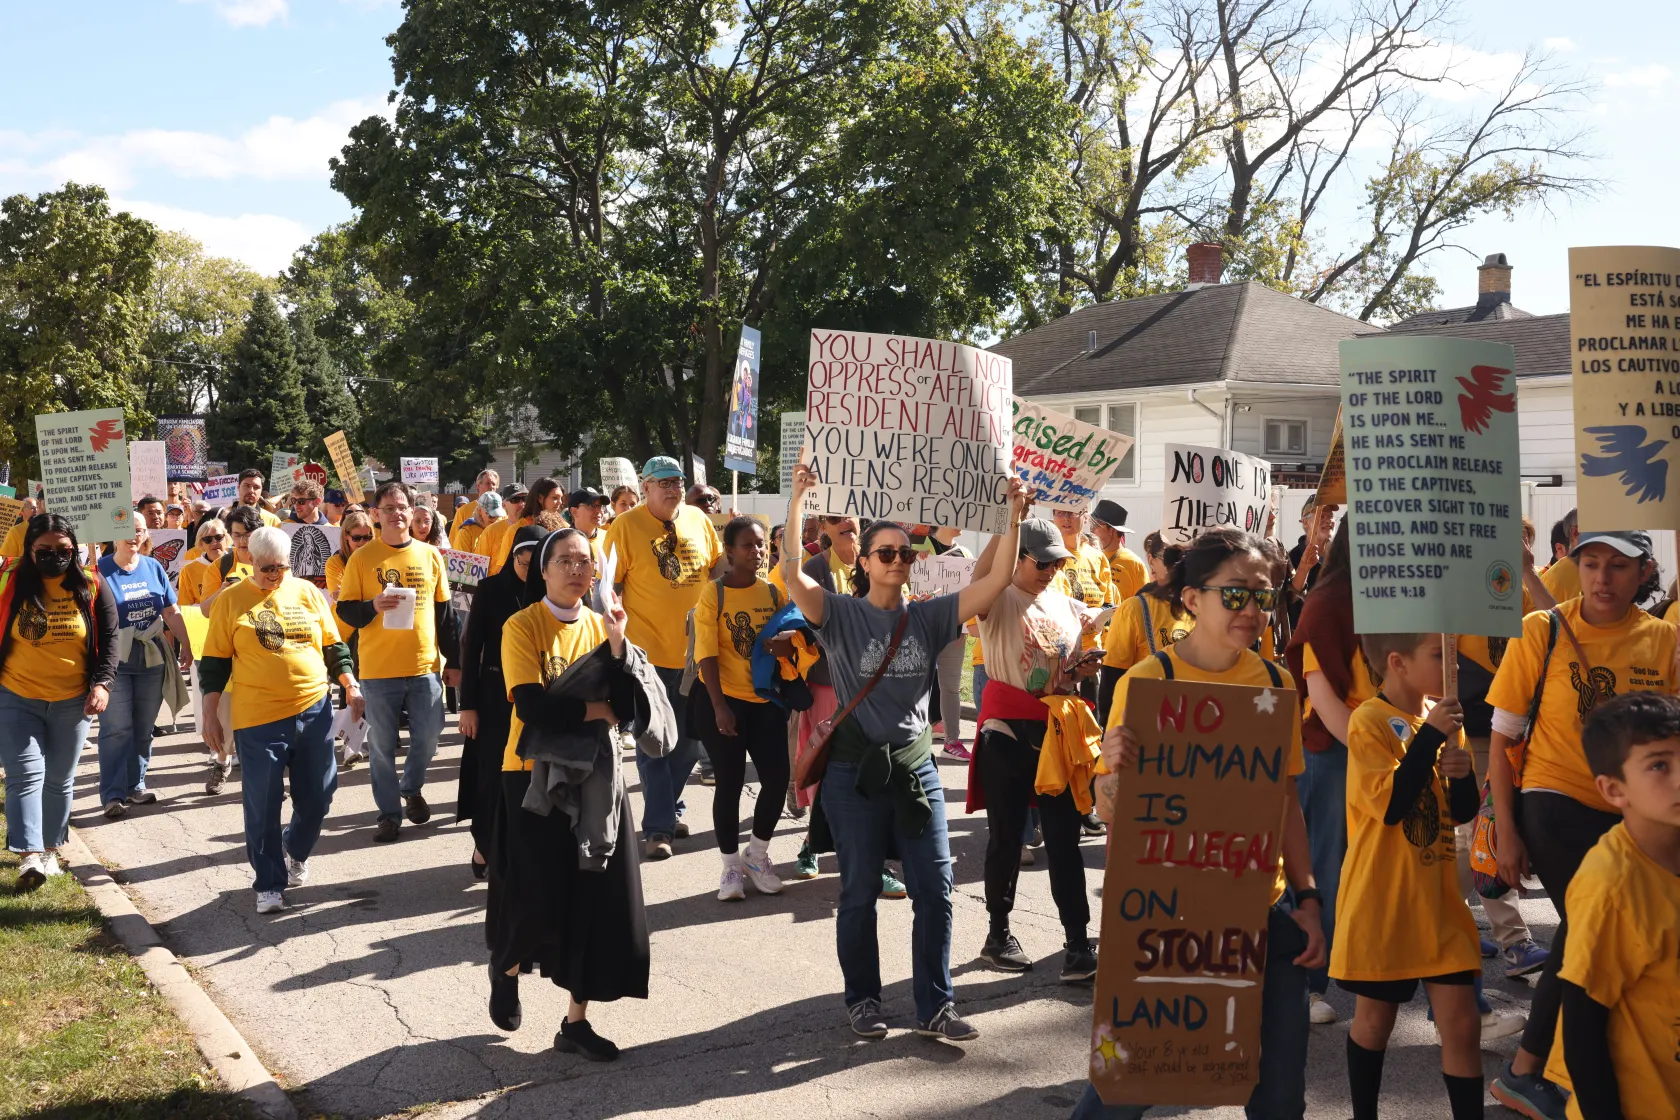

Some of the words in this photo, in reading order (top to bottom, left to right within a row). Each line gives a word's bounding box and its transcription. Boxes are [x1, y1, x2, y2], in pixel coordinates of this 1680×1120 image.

[1576, 273, 1601, 287] “EL
[1606, 269, 1671, 287] ESPÍRITU
[1630, 290, 1664, 307] ESTÁ
[1626, 314, 1646, 329] ME
[1651, 315, 1670, 329] HA
[1578, 336, 1667, 352] PROCLAMAR
[812, 332, 871, 362] YOU
[885, 338, 963, 374] SHALL
[975, 352, 1010, 386] NOT
[1581, 359, 1611, 374] LOS
[1618, 357, 1680, 373] CAUTIVO
[1348, 371, 1383, 384] “THE
[1389, 369, 1437, 383] SPIRIT
[810, 361, 917, 398] OPPRESS
[917, 374, 931, 385] or
[929, 373, 1006, 413] AFFLICT
[1655, 380, 1664, 394] A
[1349, 393, 1368, 406] OF
[1373, 391, 1400, 405] THE
[1406, 391, 1443, 405] LORD
[1618, 403, 1628, 417] Y
[1635, 402, 1645, 416] A
[808, 390, 937, 434] RESIDENT
[942, 405, 1005, 448] ALIEN,
[1350, 414, 1365, 428] IS
[1371, 412, 1411, 427] UPON
[1416, 412, 1447, 427] ME...
[58, 427, 78, 435] SPIRIT
[65, 436, 82, 444] LORD
[1351, 435, 1369, 449] HE
[1375, 434, 1404, 448] HAS
[1410, 434, 1444, 448] SENT
[1450, 435, 1465, 449] ME
[806, 424, 864, 458] YOU
[874, 430, 944, 465] WERE
[950, 440, 1006, 475] ONCE
[1087, 438, 1118, 476] by
[68, 455, 84, 463] SENT
[1013, 445, 1076, 479] grants
[1353, 457, 1372, 471] TO
[1377, 456, 1448, 470] PROCLAIM
[1453, 457, 1503, 475] RELEASE
[55, 465, 86, 474] PROCLAIM
[89, 462, 117, 472] RELEASE
[1171, 451, 1204, 484] NO
[1212, 455, 1244, 490] ONE
[70, 474, 103, 482] CAPTIVES,
[305, 472, 325, 482] TOP
[808, 455, 902, 490] ALIENS
[913, 464, 1008, 506] RESIDING
[47, 485, 75, 494] RECOVER
[77, 483, 97, 491] SIGHT
[202, 489, 219, 500] MELT
[221, 486, 236, 498] ICE
[808, 489, 818, 499] in
[1354, 478, 1373, 492] TO
[1378, 477, 1406, 491] THE
[1411, 477, 1476, 495] CAPTIVES,
[48, 496, 69, 505] BLIND,
[70, 494, 84, 502] AND
[100, 491, 116, 499] FREE
[803, 501, 821, 511] the
[826, 487, 893, 518] LAND
[897, 497, 913, 512] of
[49, 505, 69, 513] THOSE
[71, 504, 87, 512] WHO
[89, 502, 102, 510] ARE
[920, 496, 991, 531] EGYPT.
[1355, 499, 1423, 514] RECOVER
[1428, 499, 1465, 515] SIGHT
[1469, 502, 1485, 516] TO
[1489, 503, 1509, 519] THE
[1246, 505, 1265, 534] ON
[1356, 521, 1405, 537] BLIND,
[1410, 521, 1438, 535] AND
[1443, 522, 1465, 537] SET
[1469, 524, 1497, 539] FREE
[1357, 543, 1406, 557] THOSE
[1411, 543, 1446, 557] WHO
[1450, 544, 1472, 559] ARE
[913, 559, 930, 582] Only
[936, 561, 961, 584] Thing
[1358, 565, 1449, 579] OPPRESSED”
[121, 581, 148, 591] peace
[1360, 586, 1397, 598] -LUKE
[1401, 586, 1426, 598] 4:18
[127, 601, 154, 609] MERCY
[1647, 667, 1660, 676] has
[1157, 694, 1225, 734] NO
[1137, 742, 1282, 784] HUMAN
[1133, 793, 1188, 826] IS
[1136, 829, 1279, 879] ILLEGAL
[1120, 887, 1178, 922] ON
[1134, 928, 1268, 976] STOLEN
[1128, 1041, 1158, 1061] Your
[1163, 1040, 1173, 1057] 8
[1186, 1060, 1197, 1073] be
